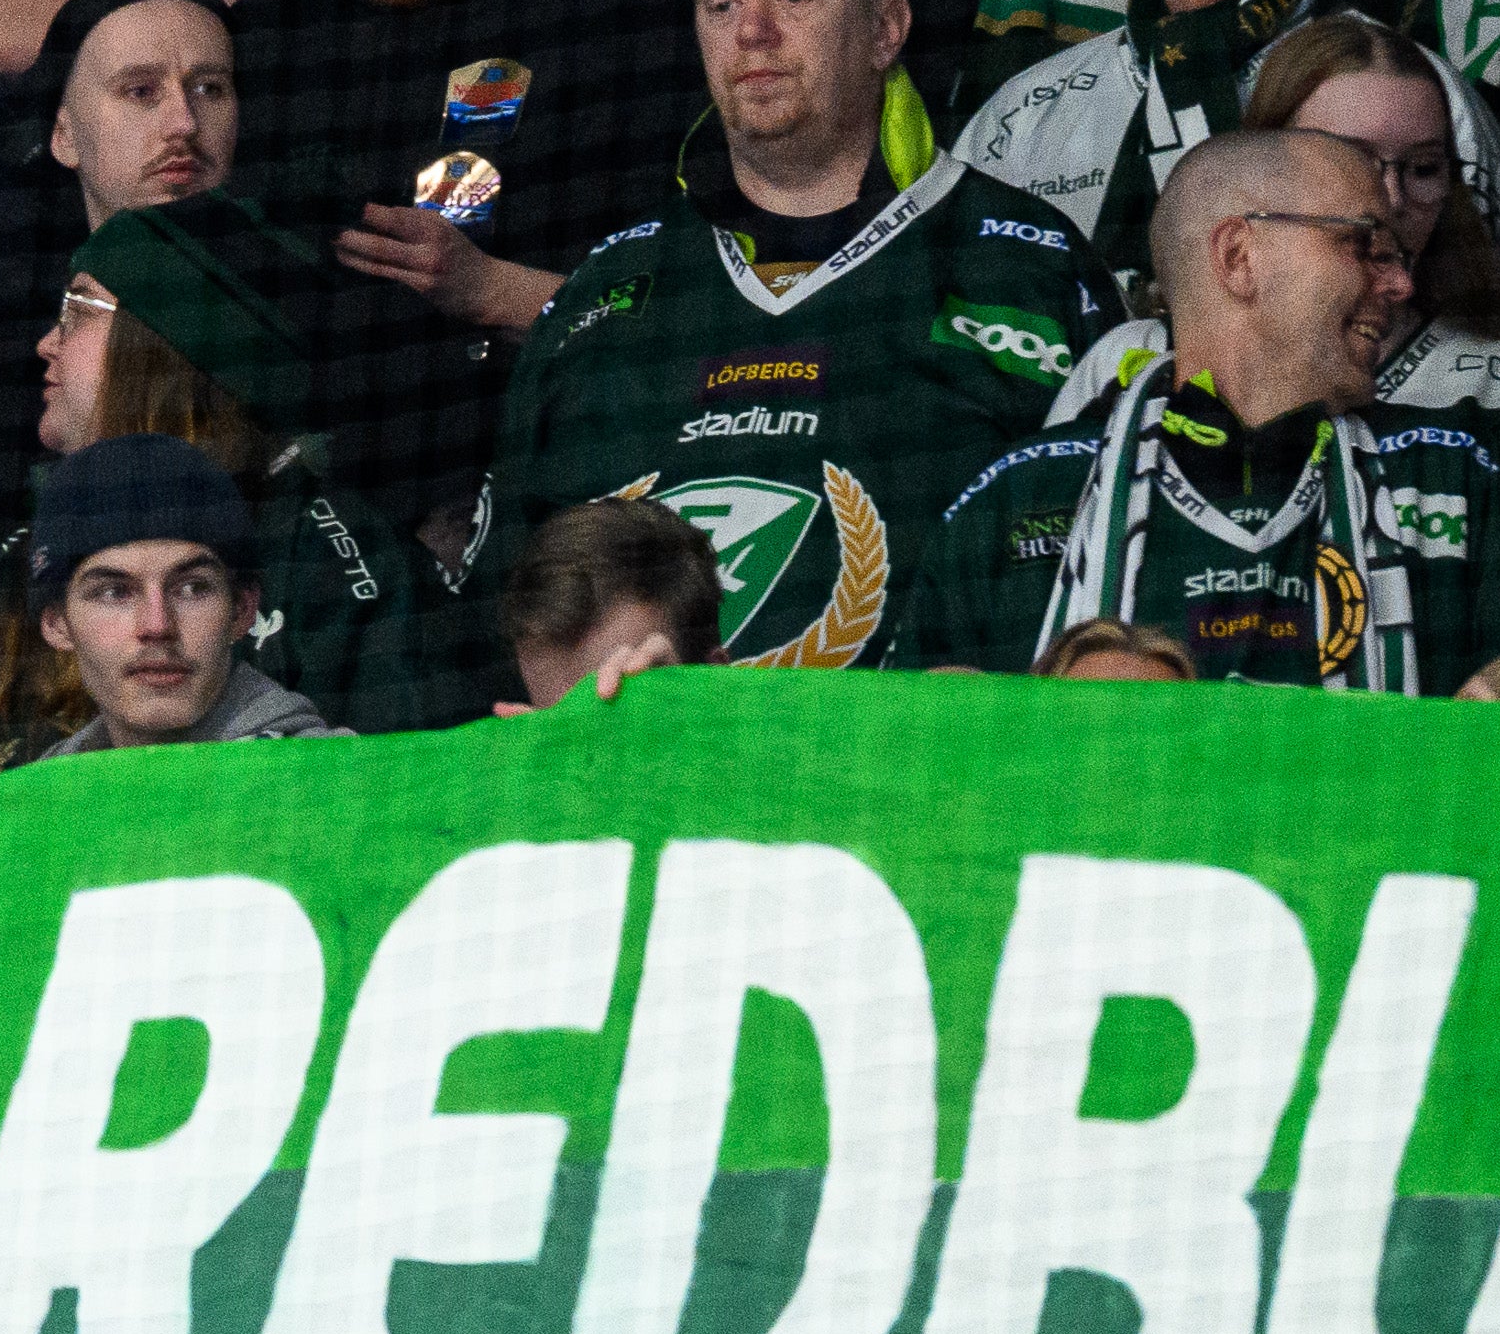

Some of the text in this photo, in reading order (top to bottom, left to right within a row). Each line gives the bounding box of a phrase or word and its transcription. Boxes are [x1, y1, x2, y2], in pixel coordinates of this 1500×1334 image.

[828, 200, 920, 273] stadium
[951, 316, 1073, 378] coop
[706, 361, 820, 389] LÖFBERGS
[677, 405, 818, 445] stadium
[1184, 563, 1310, 603] stadium
